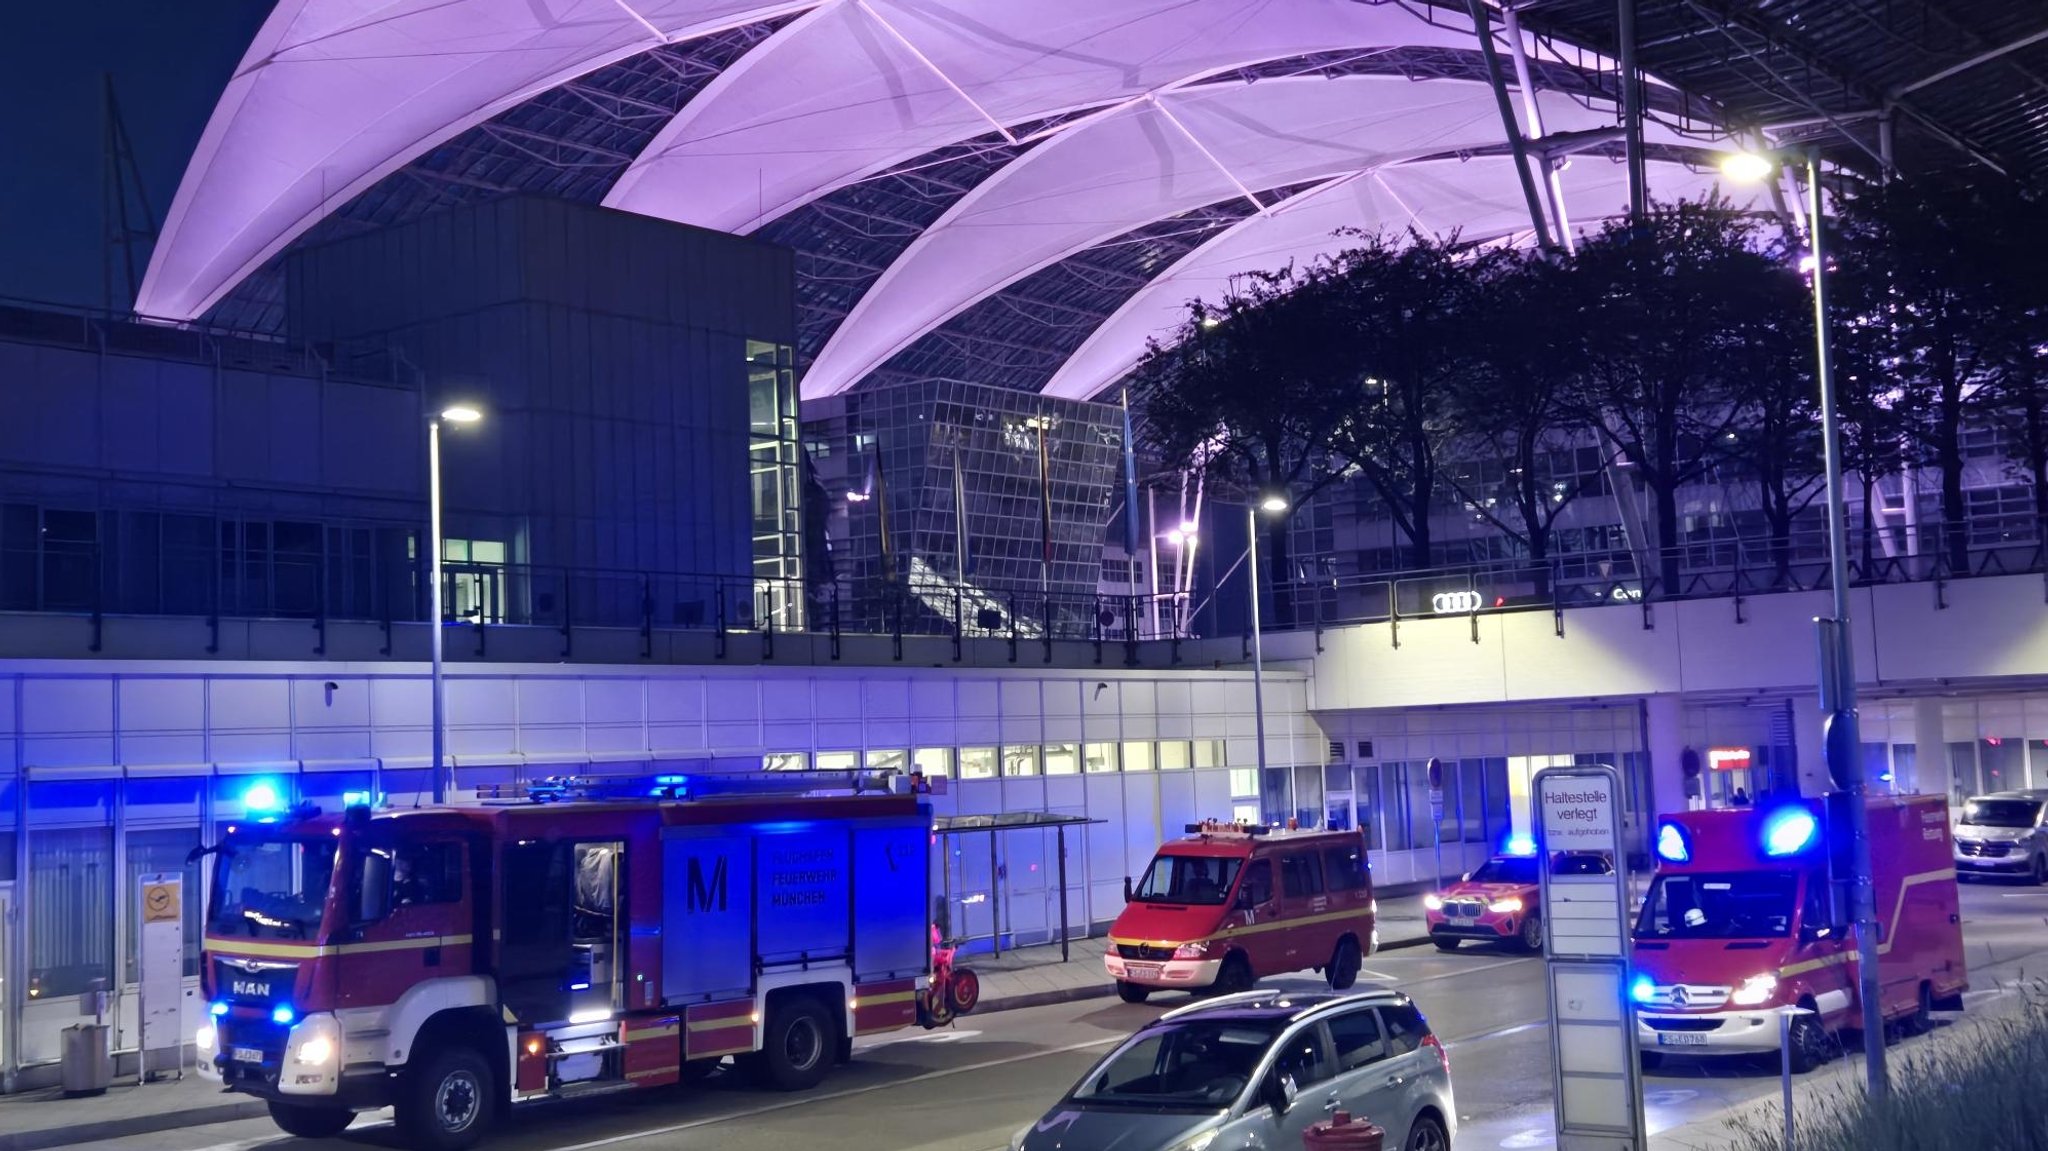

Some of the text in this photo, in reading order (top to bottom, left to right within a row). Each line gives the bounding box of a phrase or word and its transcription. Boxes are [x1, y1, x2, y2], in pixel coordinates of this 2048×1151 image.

[1545, 791, 1607, 804] Haltestelle
[1557, 808, 1598, 822] verlegt
[687, 855, 727, 914] M
[772, 869, 838, 886] FEUERWEHR
[233, 981, 270, 996] MAN
